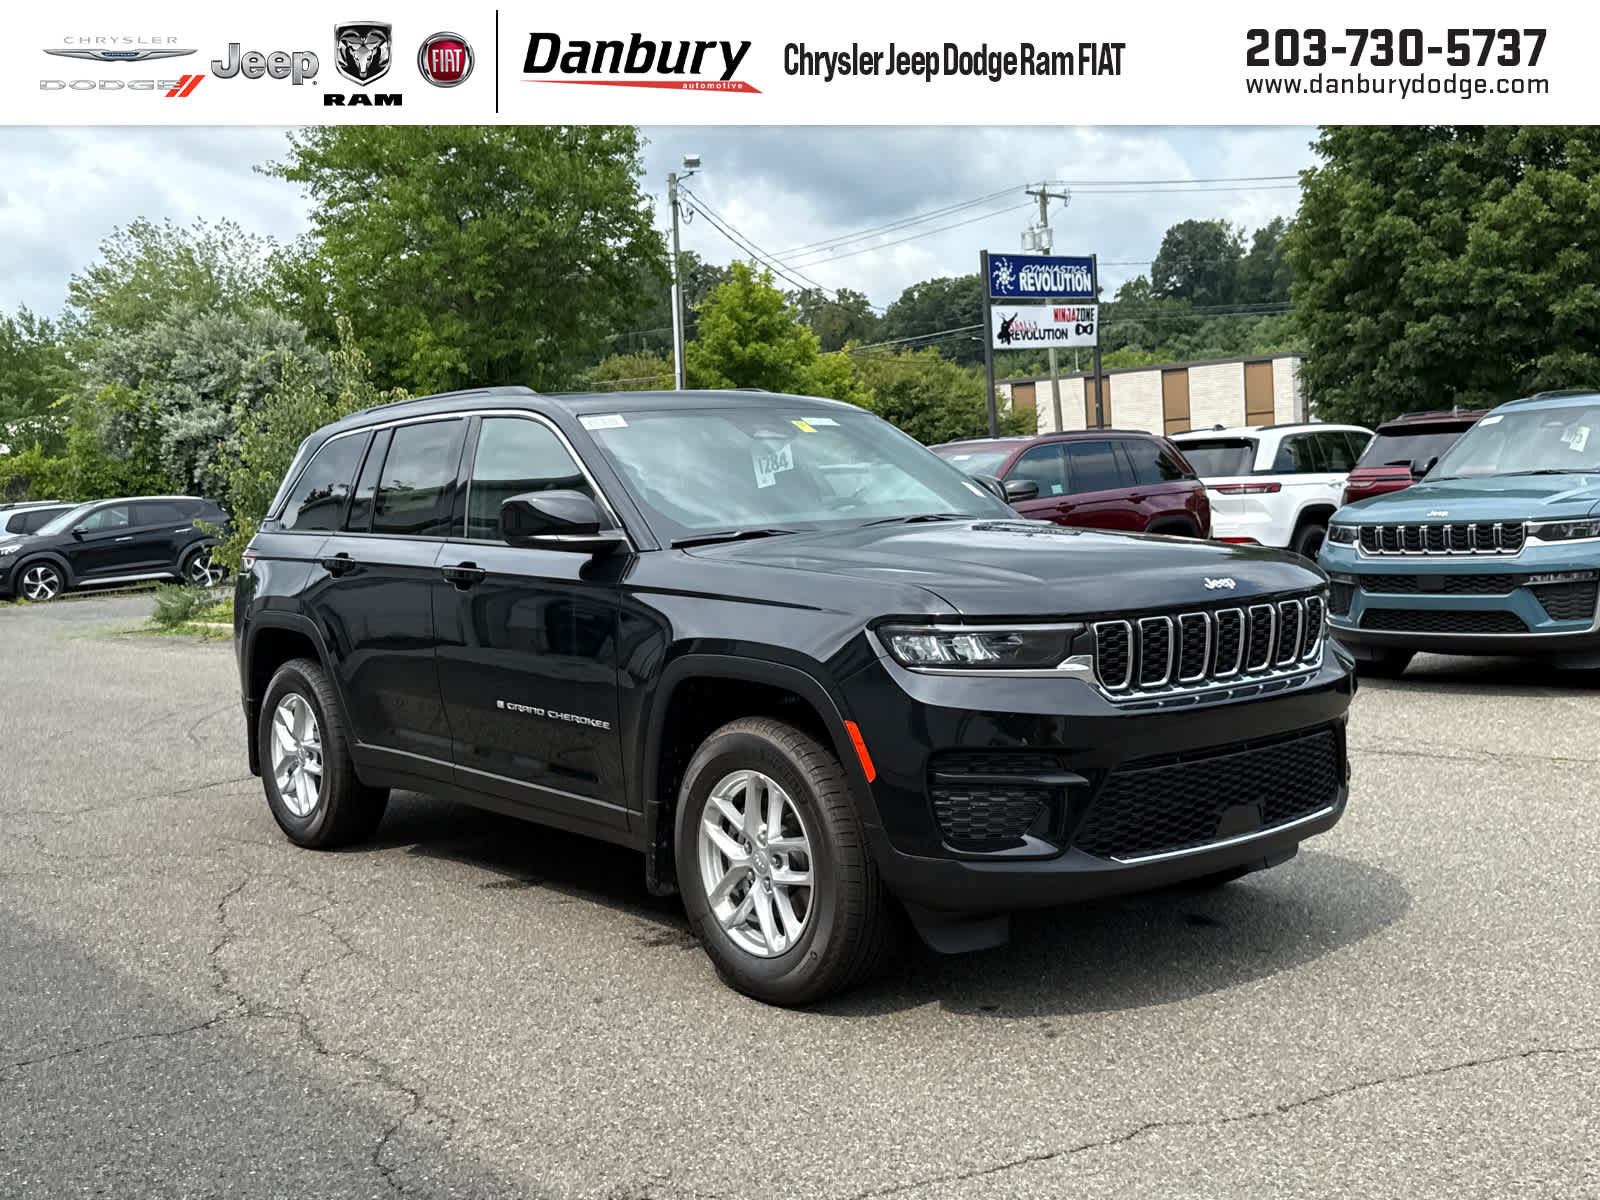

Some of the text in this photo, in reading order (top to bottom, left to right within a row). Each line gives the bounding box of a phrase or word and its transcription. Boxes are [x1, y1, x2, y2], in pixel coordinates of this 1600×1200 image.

[1021, 264, 1087, 274] GYMNASTICS
[1019, 272, 1092, 292] REVOLUTION
[1203, 577, 1237, 590] Jeep
[506, 702, 612, 730] GRAND CHEROKEE
